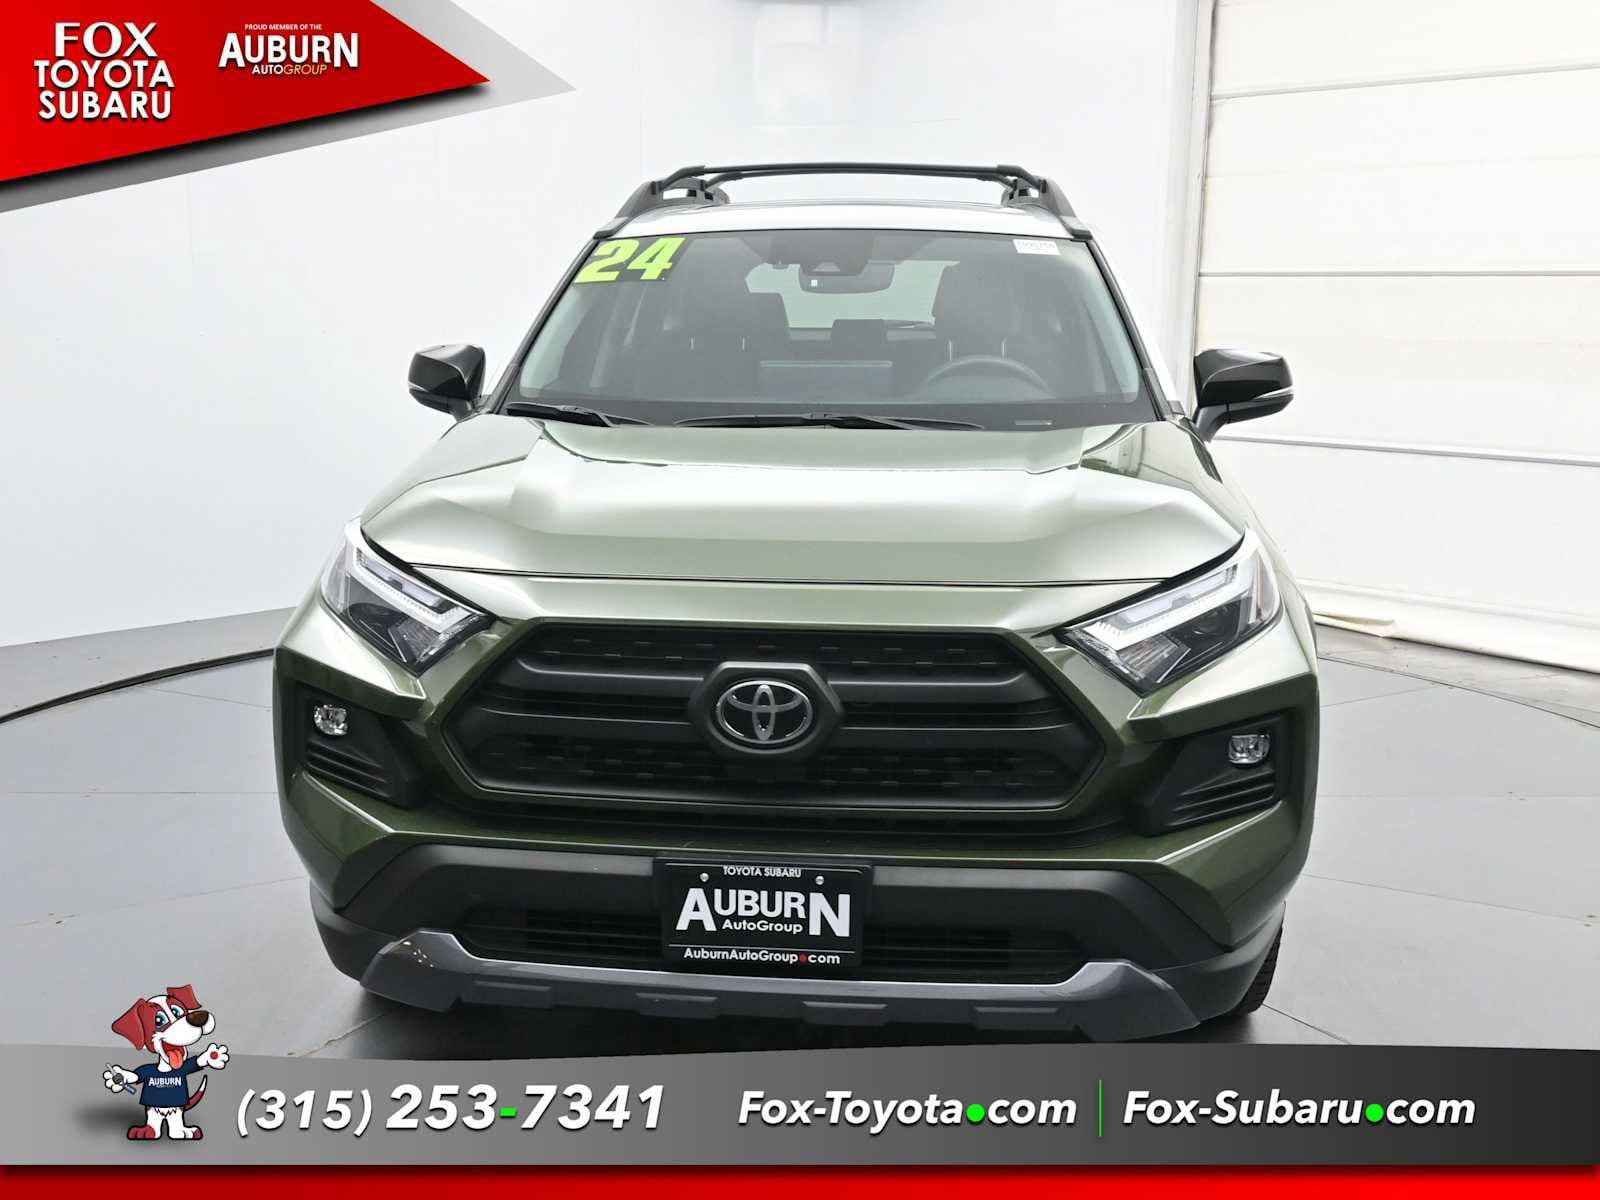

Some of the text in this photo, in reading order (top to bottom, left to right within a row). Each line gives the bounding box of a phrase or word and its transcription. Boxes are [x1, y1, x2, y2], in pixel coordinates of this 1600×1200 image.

[574, 237, 685, 283] 24
[723, 866, 802, 878] TOYOTA SUBARU
[675, 887, 851, 937] AUBURN
[722, 919, 803, 935] AutoGroup
